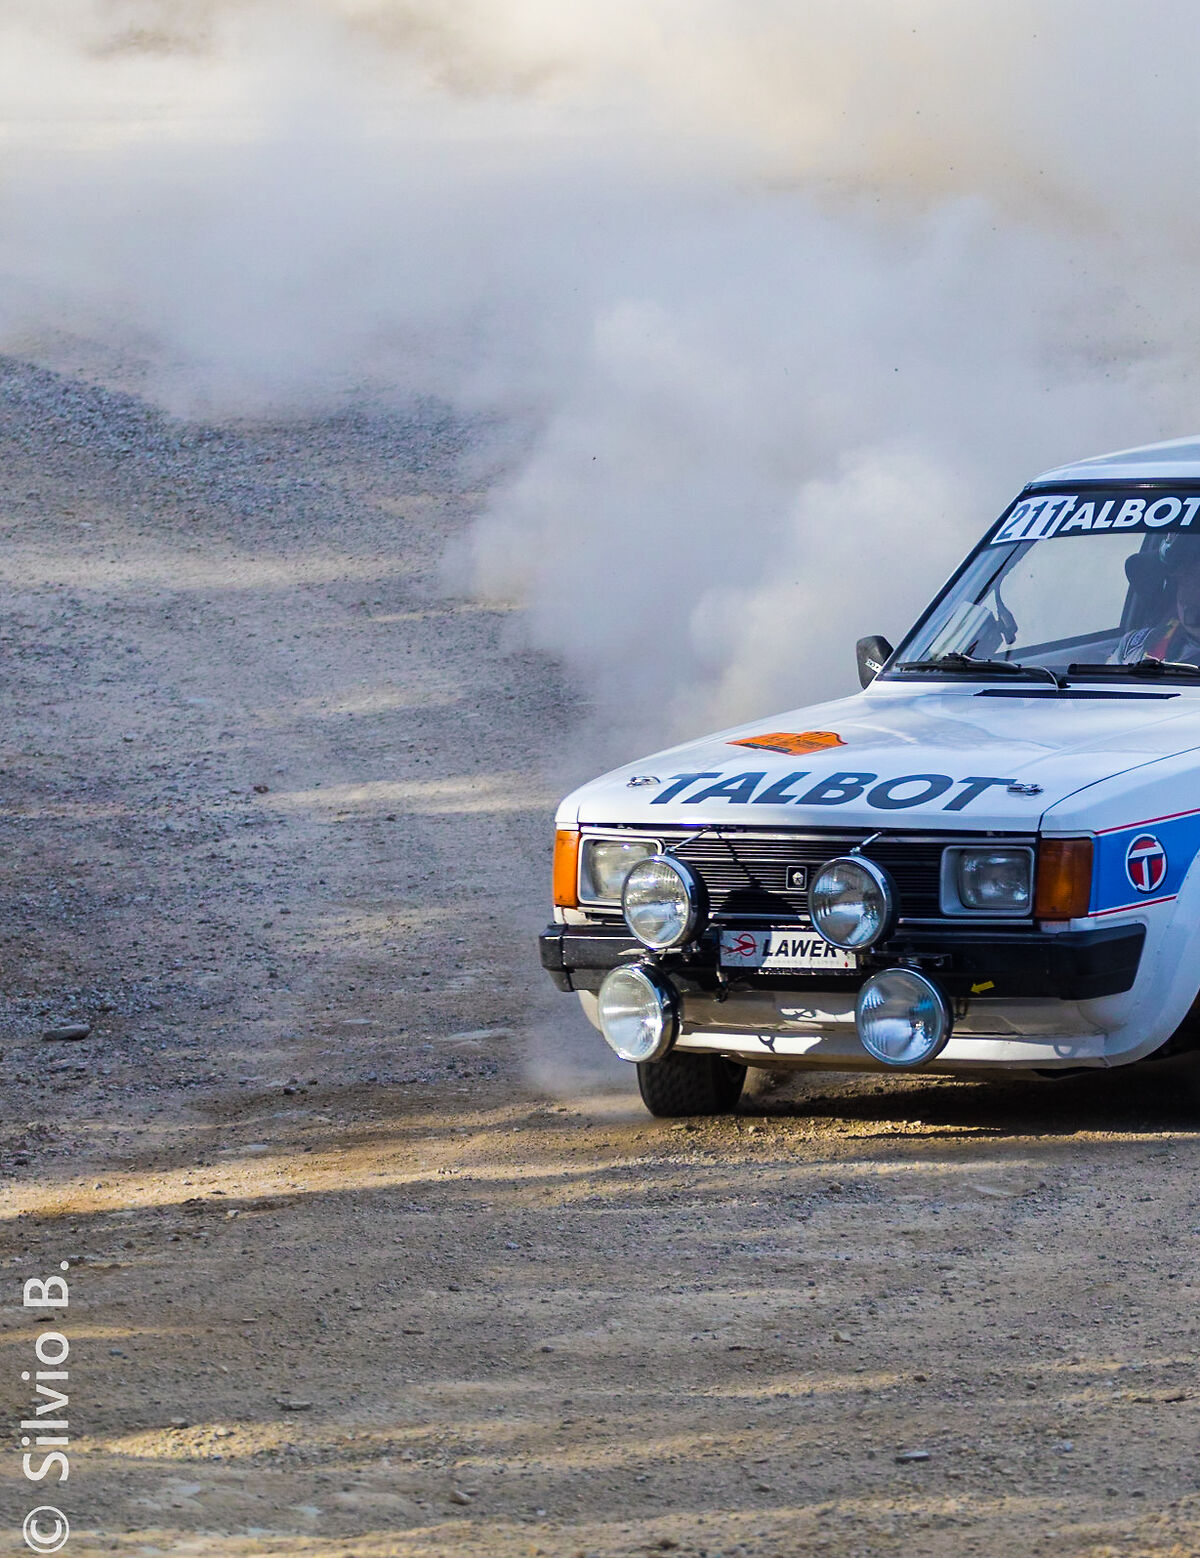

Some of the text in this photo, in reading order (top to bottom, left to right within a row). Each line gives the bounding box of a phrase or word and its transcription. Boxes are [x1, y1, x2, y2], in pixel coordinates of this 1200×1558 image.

[995, 500, 1069, 541] 211
[649, 771, 1019, 812] TALBOT
[762, 939, 837, 957] LAWER
